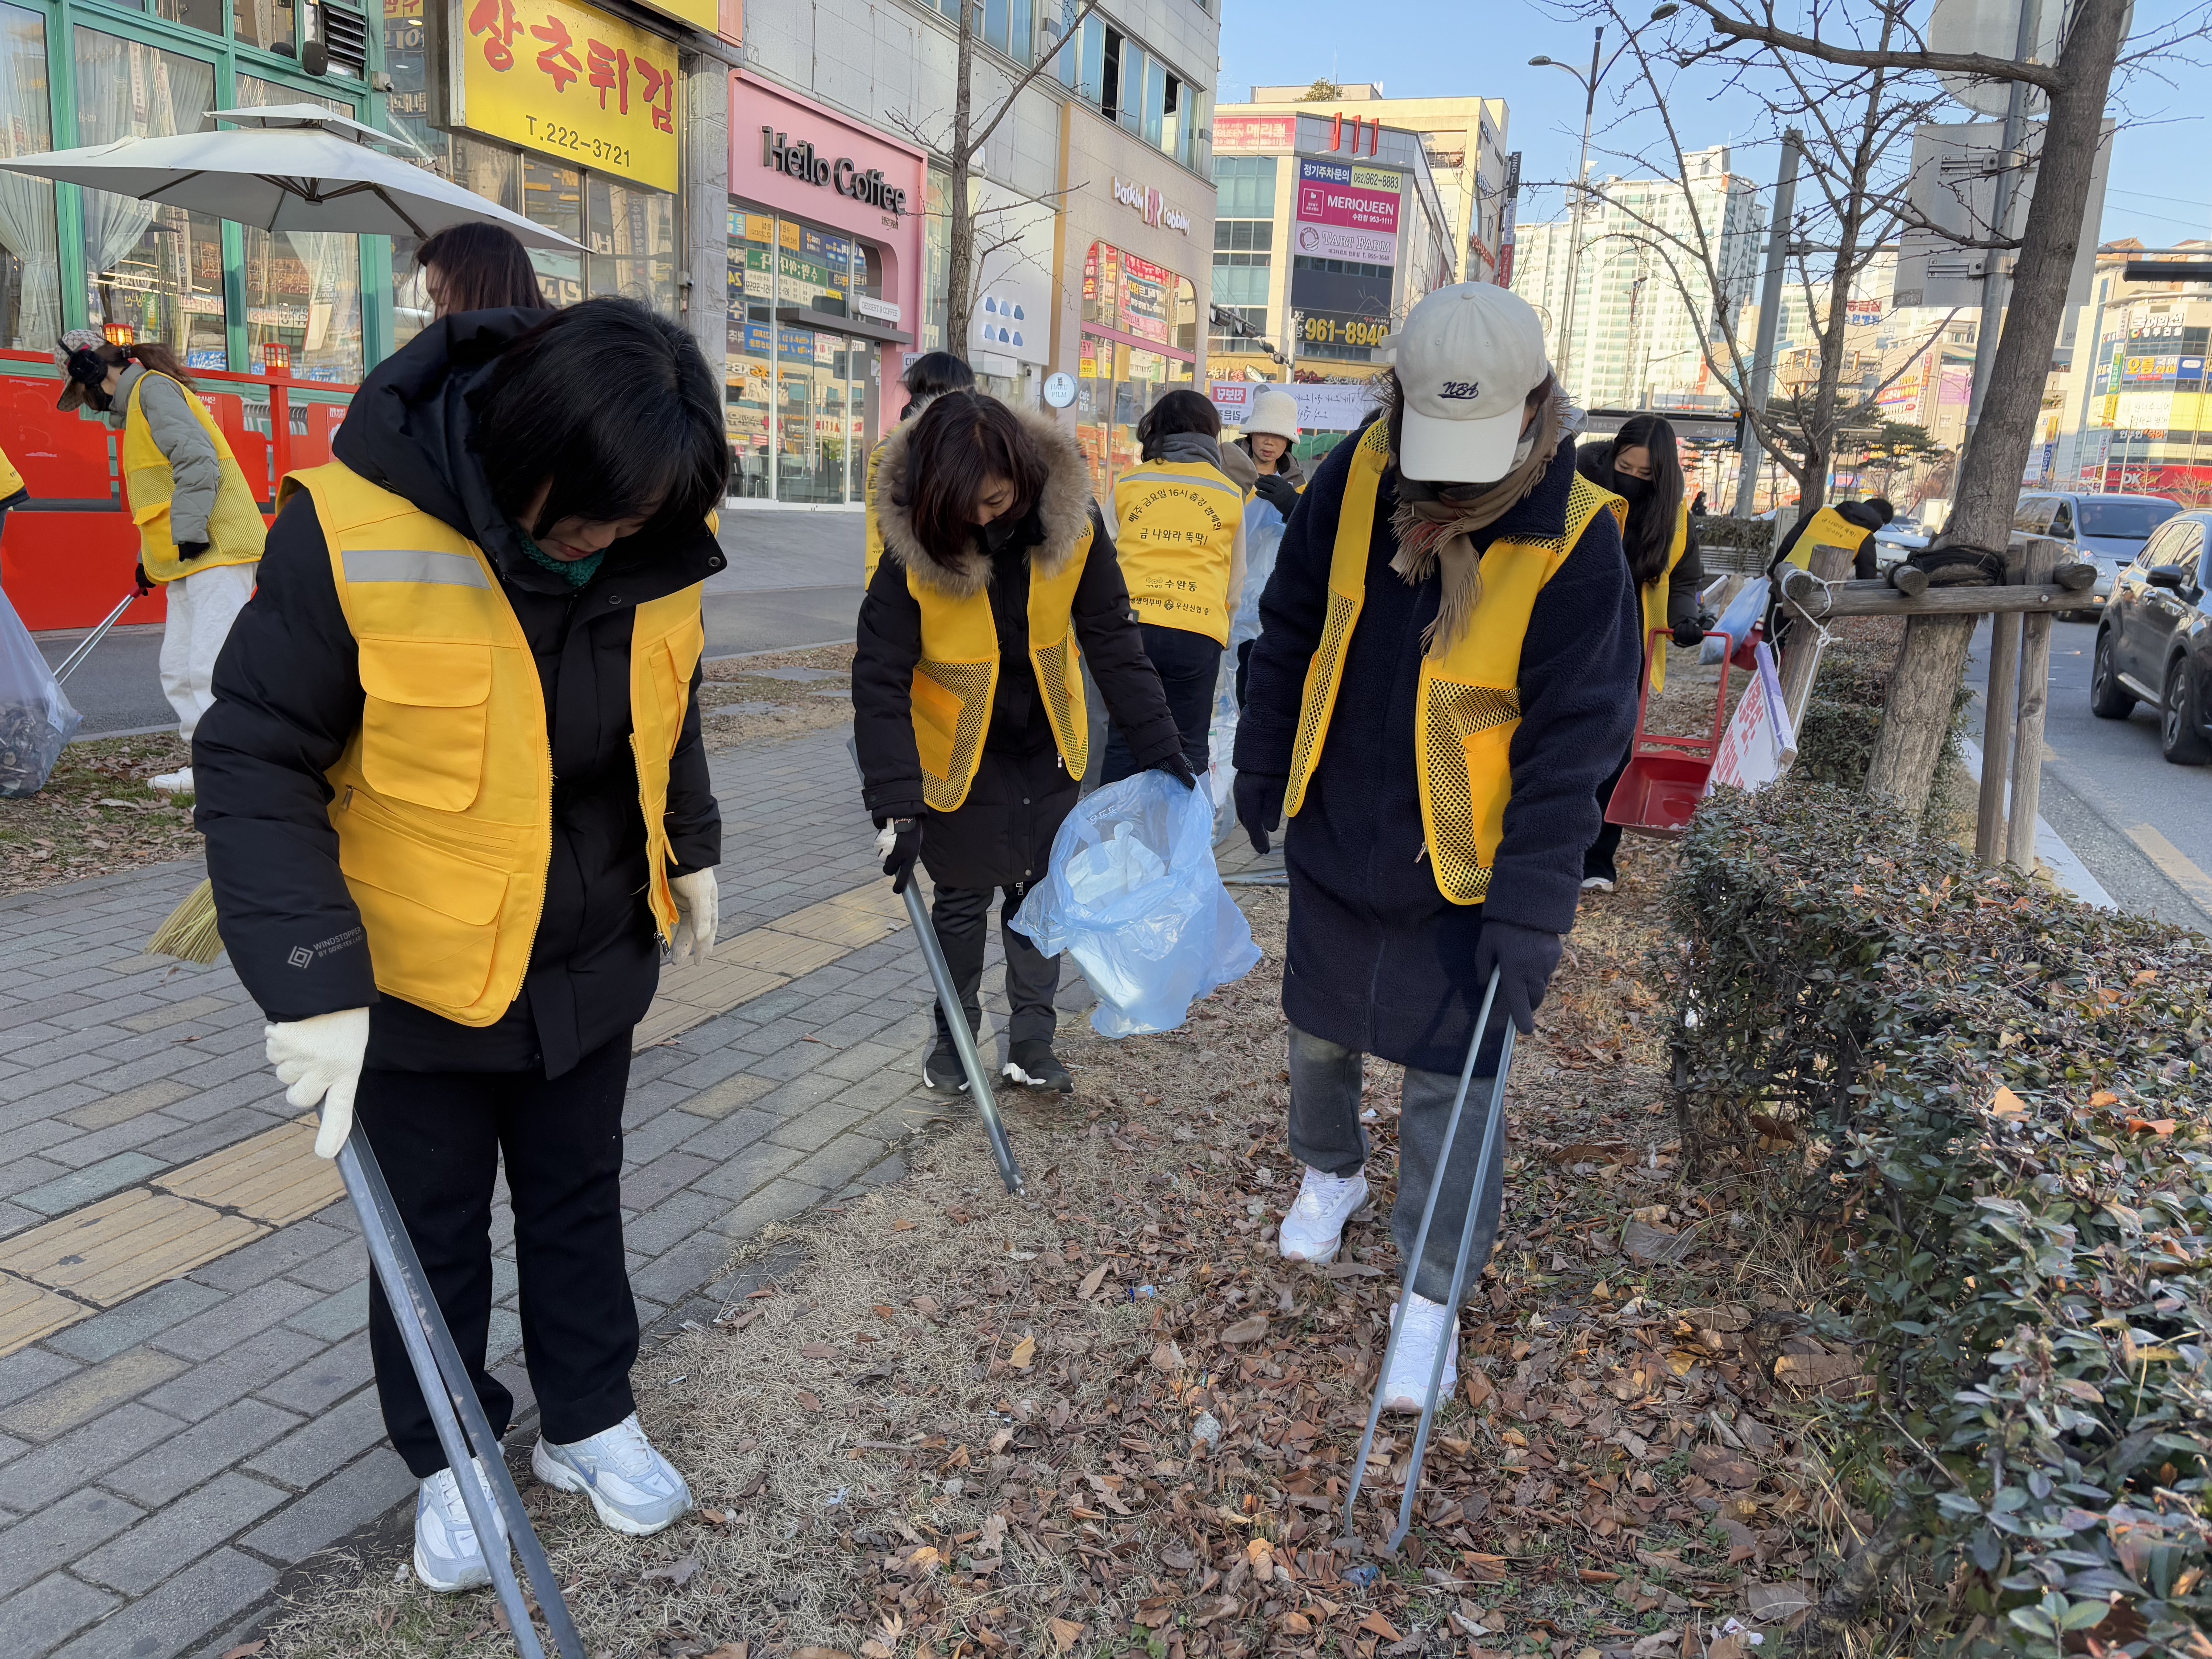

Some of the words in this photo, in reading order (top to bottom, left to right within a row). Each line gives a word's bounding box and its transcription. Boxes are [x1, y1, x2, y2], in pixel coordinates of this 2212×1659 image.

[469, 0, 674, 134] 상주튀김
[526, 115, 630, 167] T.222-3721
[762, 125, 831, 187] Hello
[833, 157, 906, 216] Coffee
[1304, 163, 1350, 182] 정기주차문의
[1354, 173, 1399, 189] 062)962-8883
[1114, 176, 1144, 213] baskin
[1328, 195, 1394, 215] MERIQUEEN
[1163, 206, 1190, 236] robbins
[1369, 215, 1393, 225] 953-1111
[1322, 231, 1354, 248] TART
[1357, 235, 1391, 252] FARM
[862, 301, 879, 312] DESSERT
[883, 306, 898, 317] COFFEE
[2125, 357, 2155, 375] 오름
[1443, 381, 1479, 396] NBA
[2123, 473, 2142, 484] DK
[1128, 505, 1142, 522] 매주
[1141, 489, 1167, 507] 금요일
[1168, 489, 1188, 498] 16시
[1140, 528, 1148, 539] 금
[1152, 529, 1182, 542] 나와라
[1185, 532, 1208, 545] 뚝딱!
[1164, 579, 1197, 592] 수완동
[313, 926, 361, 951] WINDSTOPPER
[328, 940, 352, 953] GORE-TEX
